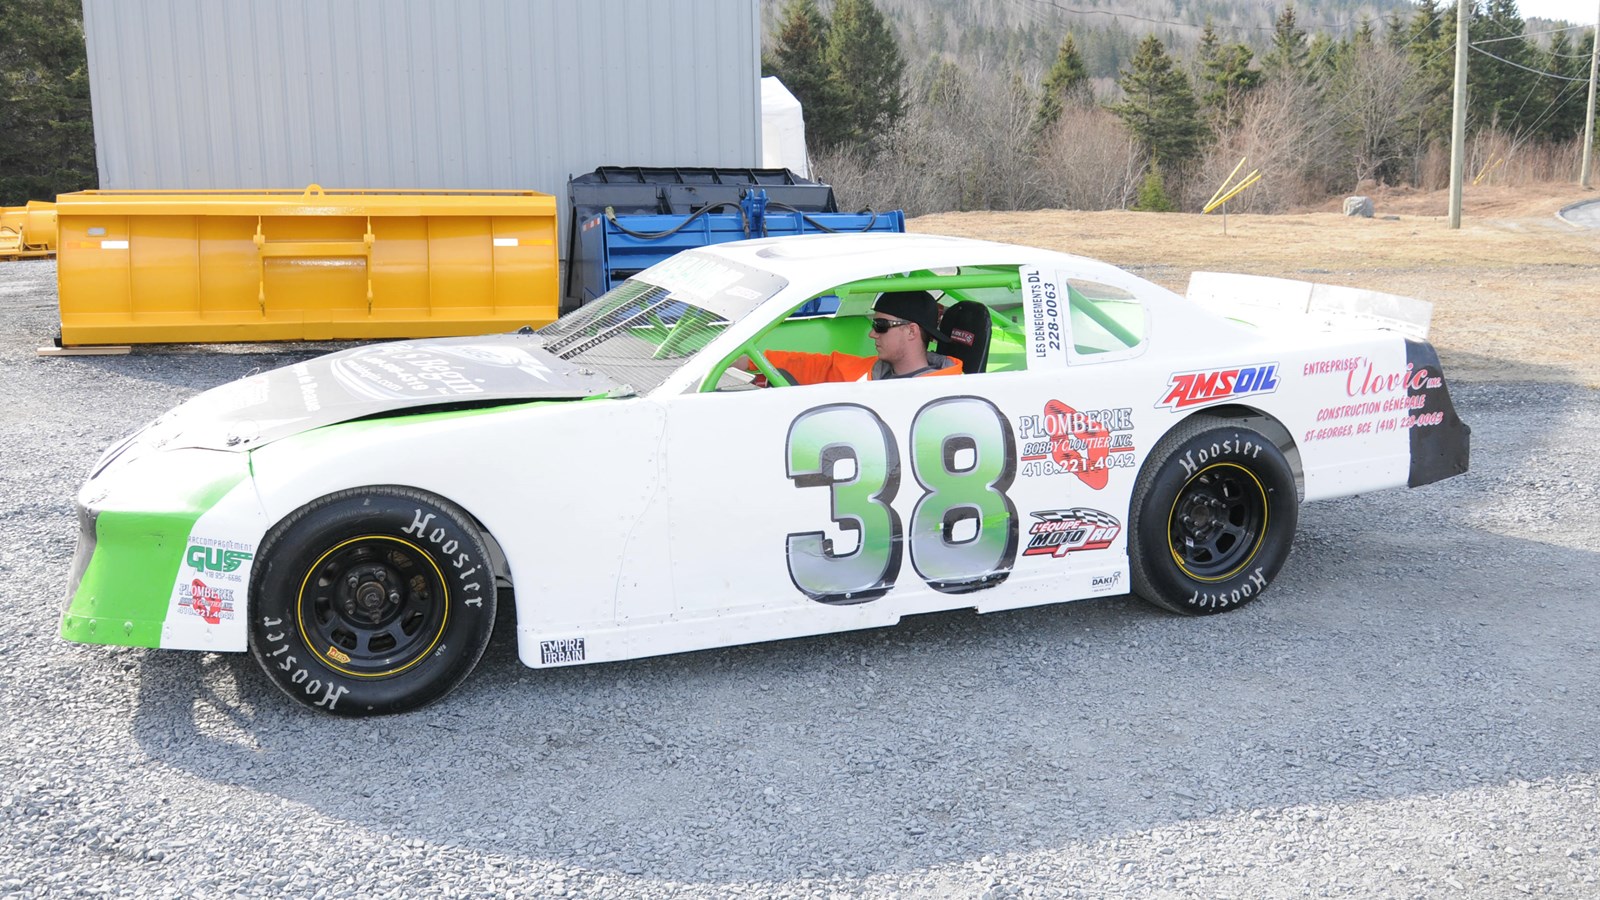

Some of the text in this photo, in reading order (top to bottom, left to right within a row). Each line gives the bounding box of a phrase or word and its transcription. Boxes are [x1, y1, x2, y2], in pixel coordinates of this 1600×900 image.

[1027, 270, 1040, 283] DL
[1044, 282, 1061, 351] 228-0063
[1035, 344, 1047, 358] LES
[1303, 356, 1362, 376] ENTREPRISES
[1161, 365, 1277, 408] AMSOIL
[1019, 408, 1134, 439] PLOMBERIE
[1316, 401, 1381, 422] CONSTRUCTION
[1356, 421, 1372, 435] BCE
[1375, 418, 1398, 434] (418)
[1400, 411, 1444, 428] 228-0063
[1023, 434, 1133, 456] BOBBY CLOUTIER INC.
[1179, 433, 1263, 480] Hoosier
[1022, 453, 1136, 477] 418.221.4042
[785, 394, 1020, 606] 38
[1028, 529, 1087, 548] MOTO
[187, 545, 253, 573] GUS
[401, 508, 483, 608] Hoosier
[1092, 577, 1113, 586] DAKI
[1188, 566, 1268, 613] Hoosier
[541, 638, 584, 653] EMPIRE
[543, 650, 584, 664] URBAIN
[263, 616, 350, 710] Hoosier
